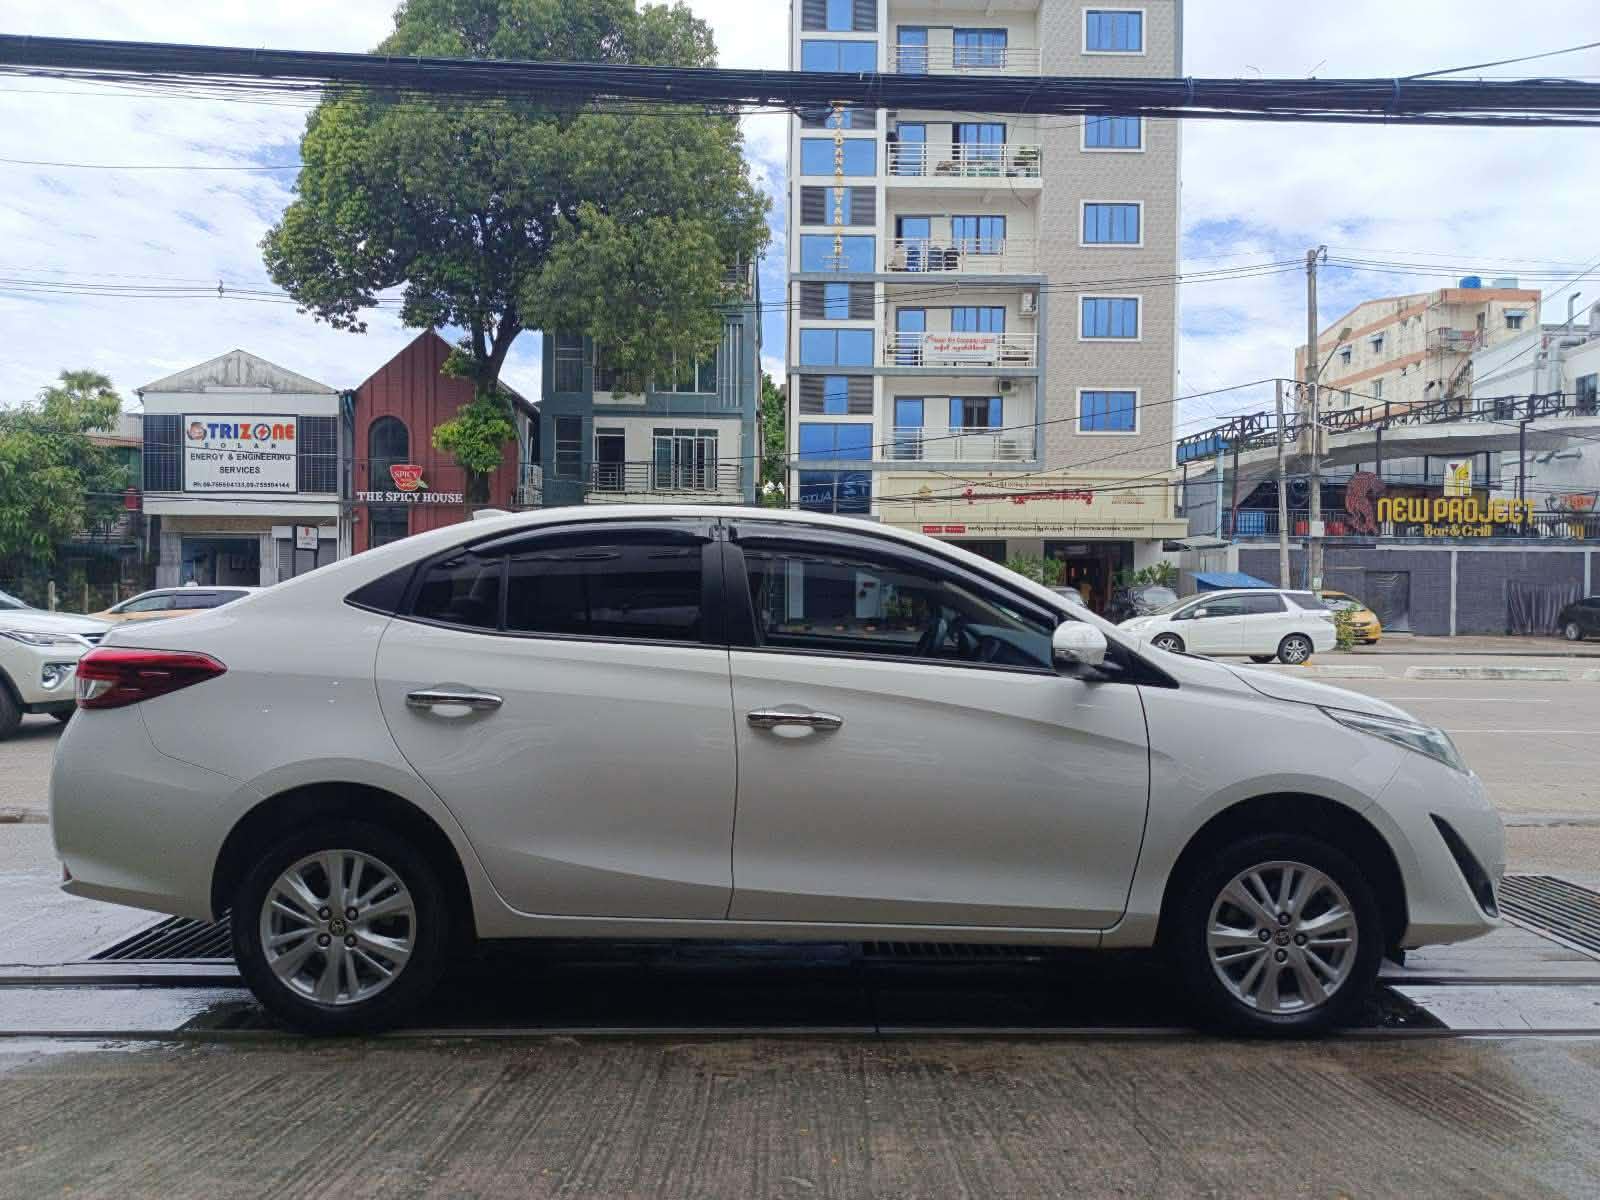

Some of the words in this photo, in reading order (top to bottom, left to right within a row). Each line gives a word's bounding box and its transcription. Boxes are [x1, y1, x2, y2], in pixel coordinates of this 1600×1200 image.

[207, 423, 295, 441] TRIZONE
[190, 453, 223, 461] ENERGY
[236, 453, 291, 461] ENGINEERING
[219, 466, 261, 474] SERVICES
[394, 470, 418, 479] SPICY
[357, 491, 383, 502] THE
[385, 491, 420, 503] SPICY
[422, 492, 464, 503] HOUSE
[1377, 497, 1429, 522] NEW
[1433, 497, 1537, 525] PROJECT
[1424, 523, 1449, 537] Bar
[1450, 523, 1461, 537] &
[1462, 524, 1493, 537] Grill
